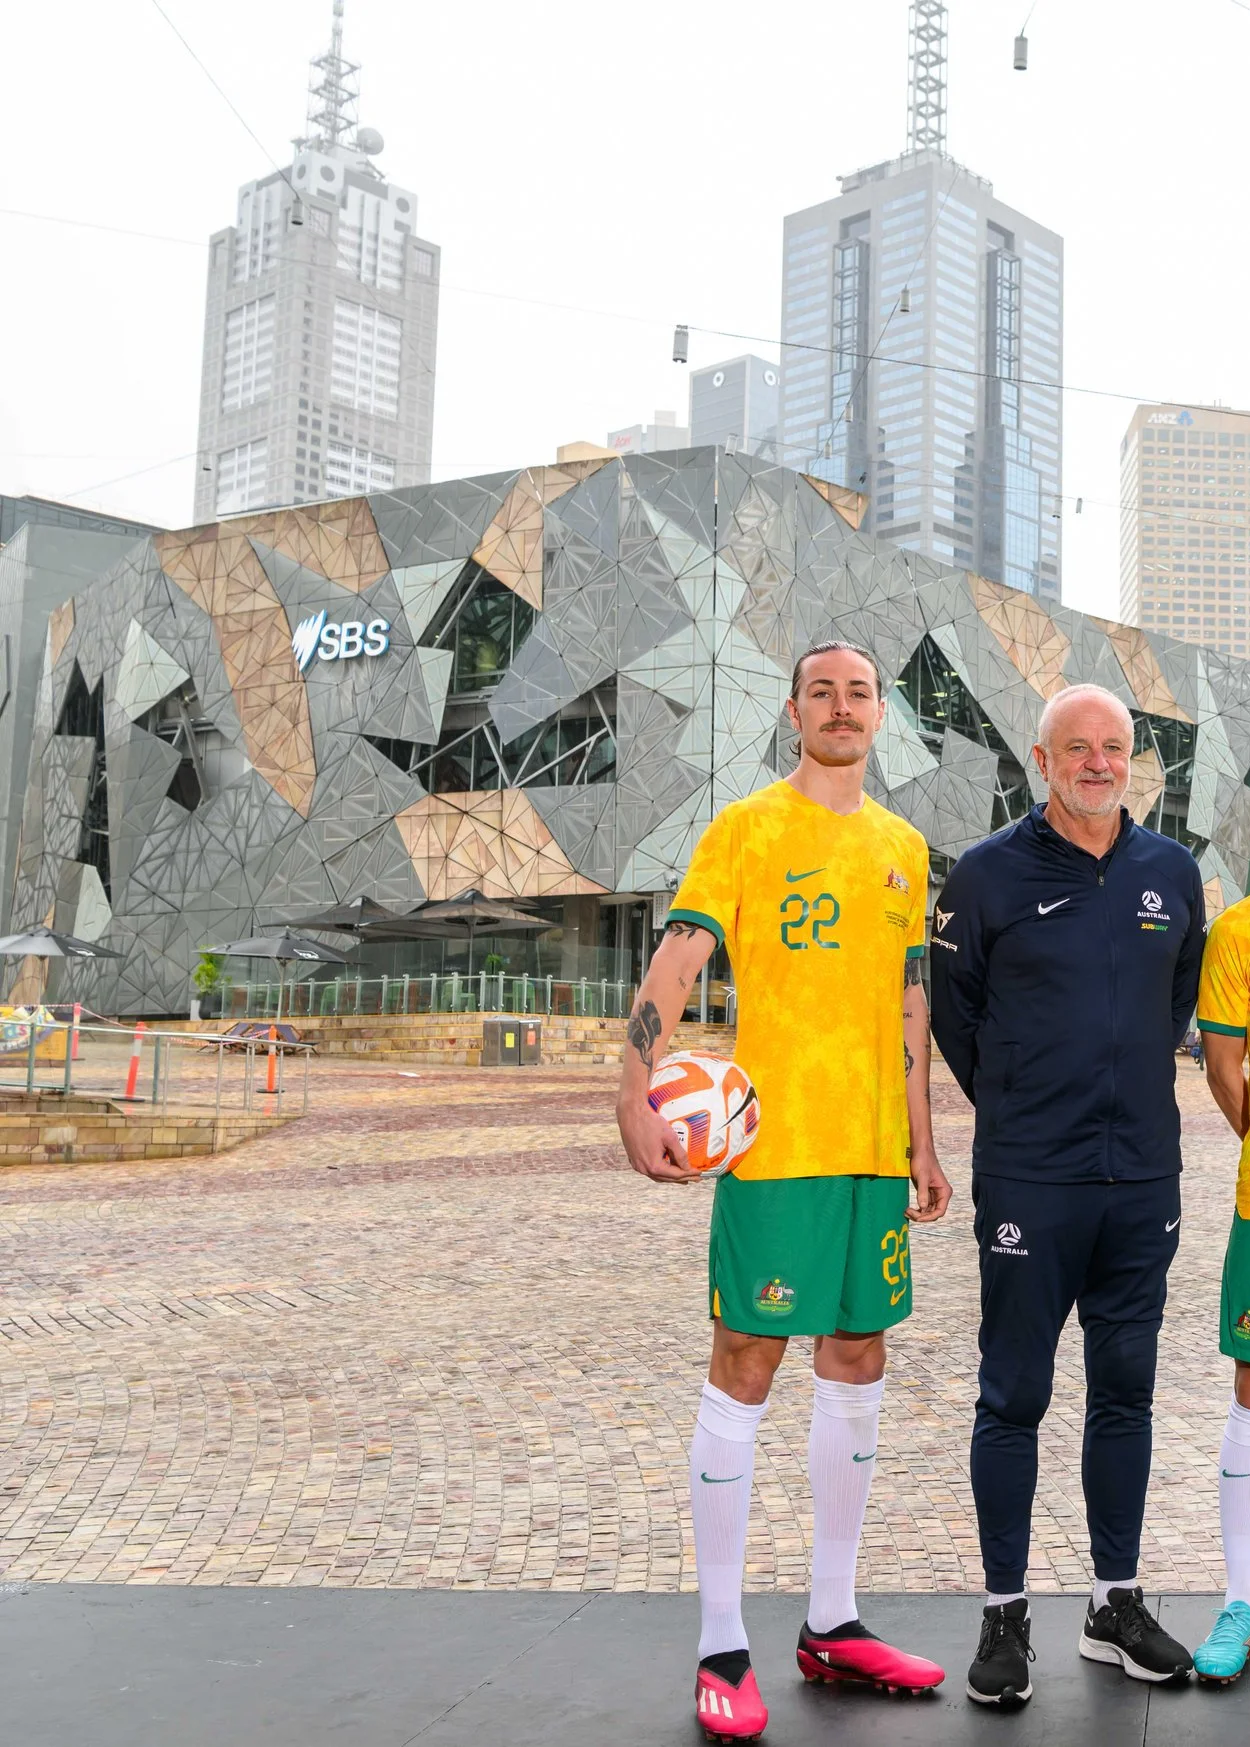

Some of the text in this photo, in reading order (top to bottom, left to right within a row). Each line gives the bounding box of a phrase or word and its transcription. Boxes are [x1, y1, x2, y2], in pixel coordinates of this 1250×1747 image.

[1148, 412, 1178, 425] ANZ
[317, 619, 390, 661] SBS
[780, 893, 841, 950] 22
[1137, 911, 1171, 920] AUSTRALIA
[1141, 923, 1168, 931] SUBWAY
[881, 1224, 909, 1285] 22
[991, 1245, 1029, 1256] AUSTRALIA
